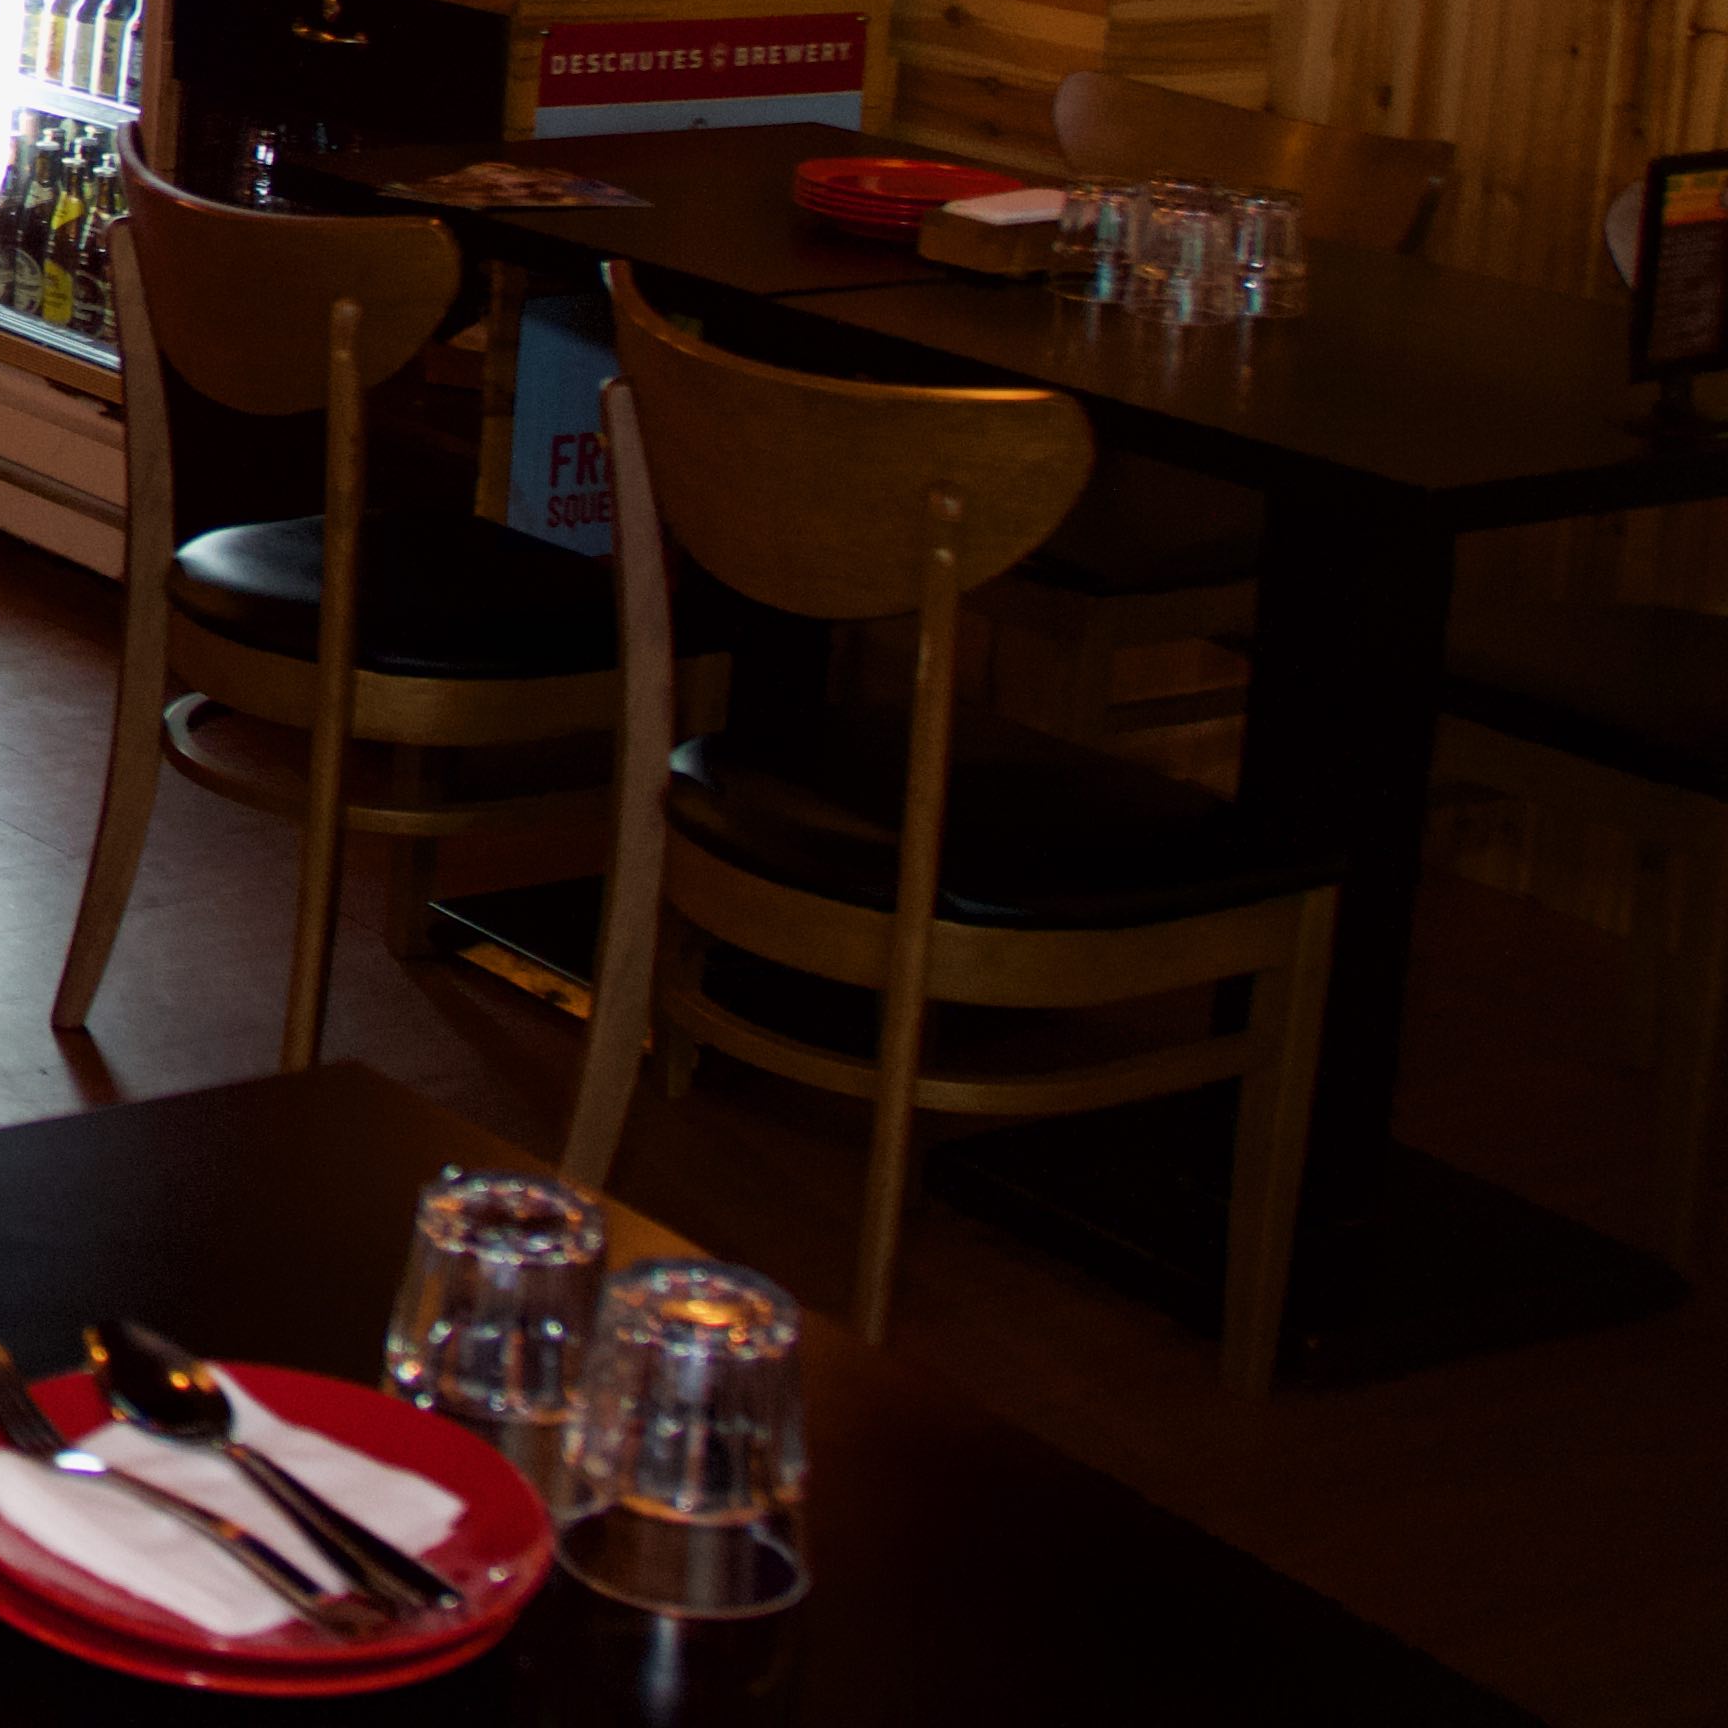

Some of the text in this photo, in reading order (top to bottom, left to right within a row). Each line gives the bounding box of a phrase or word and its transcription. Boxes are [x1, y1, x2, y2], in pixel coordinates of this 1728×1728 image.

[549, 39, 855, 76] DESCHUTES BREWERY
[549, 432, 612, 488] FR
